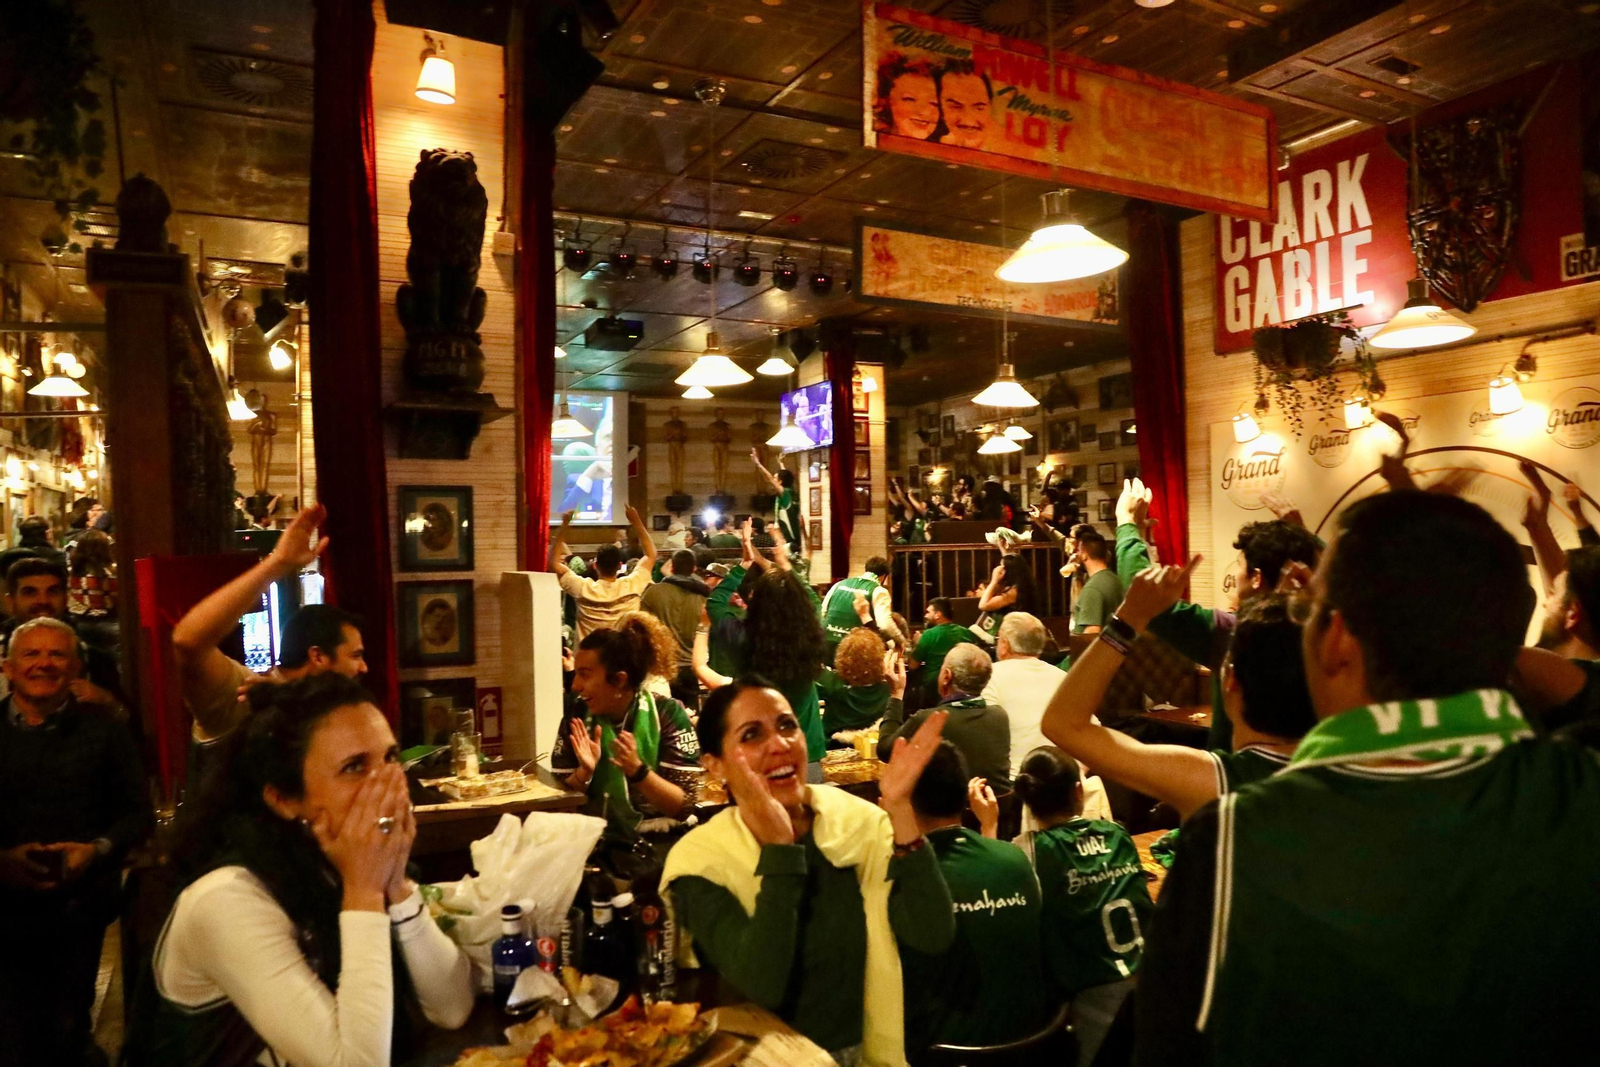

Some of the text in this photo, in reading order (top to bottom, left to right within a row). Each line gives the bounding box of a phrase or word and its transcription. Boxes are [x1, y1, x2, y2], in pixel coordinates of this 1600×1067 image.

[886, 24, 972, 58] William
[1005, 112, 1072, 152] LOY
[1220, 153, 1373, 265] CLARK
[1224, 229, 1375, 334] GABLE
[1221, 446, 1287, 490] Grand
[952, 888, 1027, 917] enahavis
